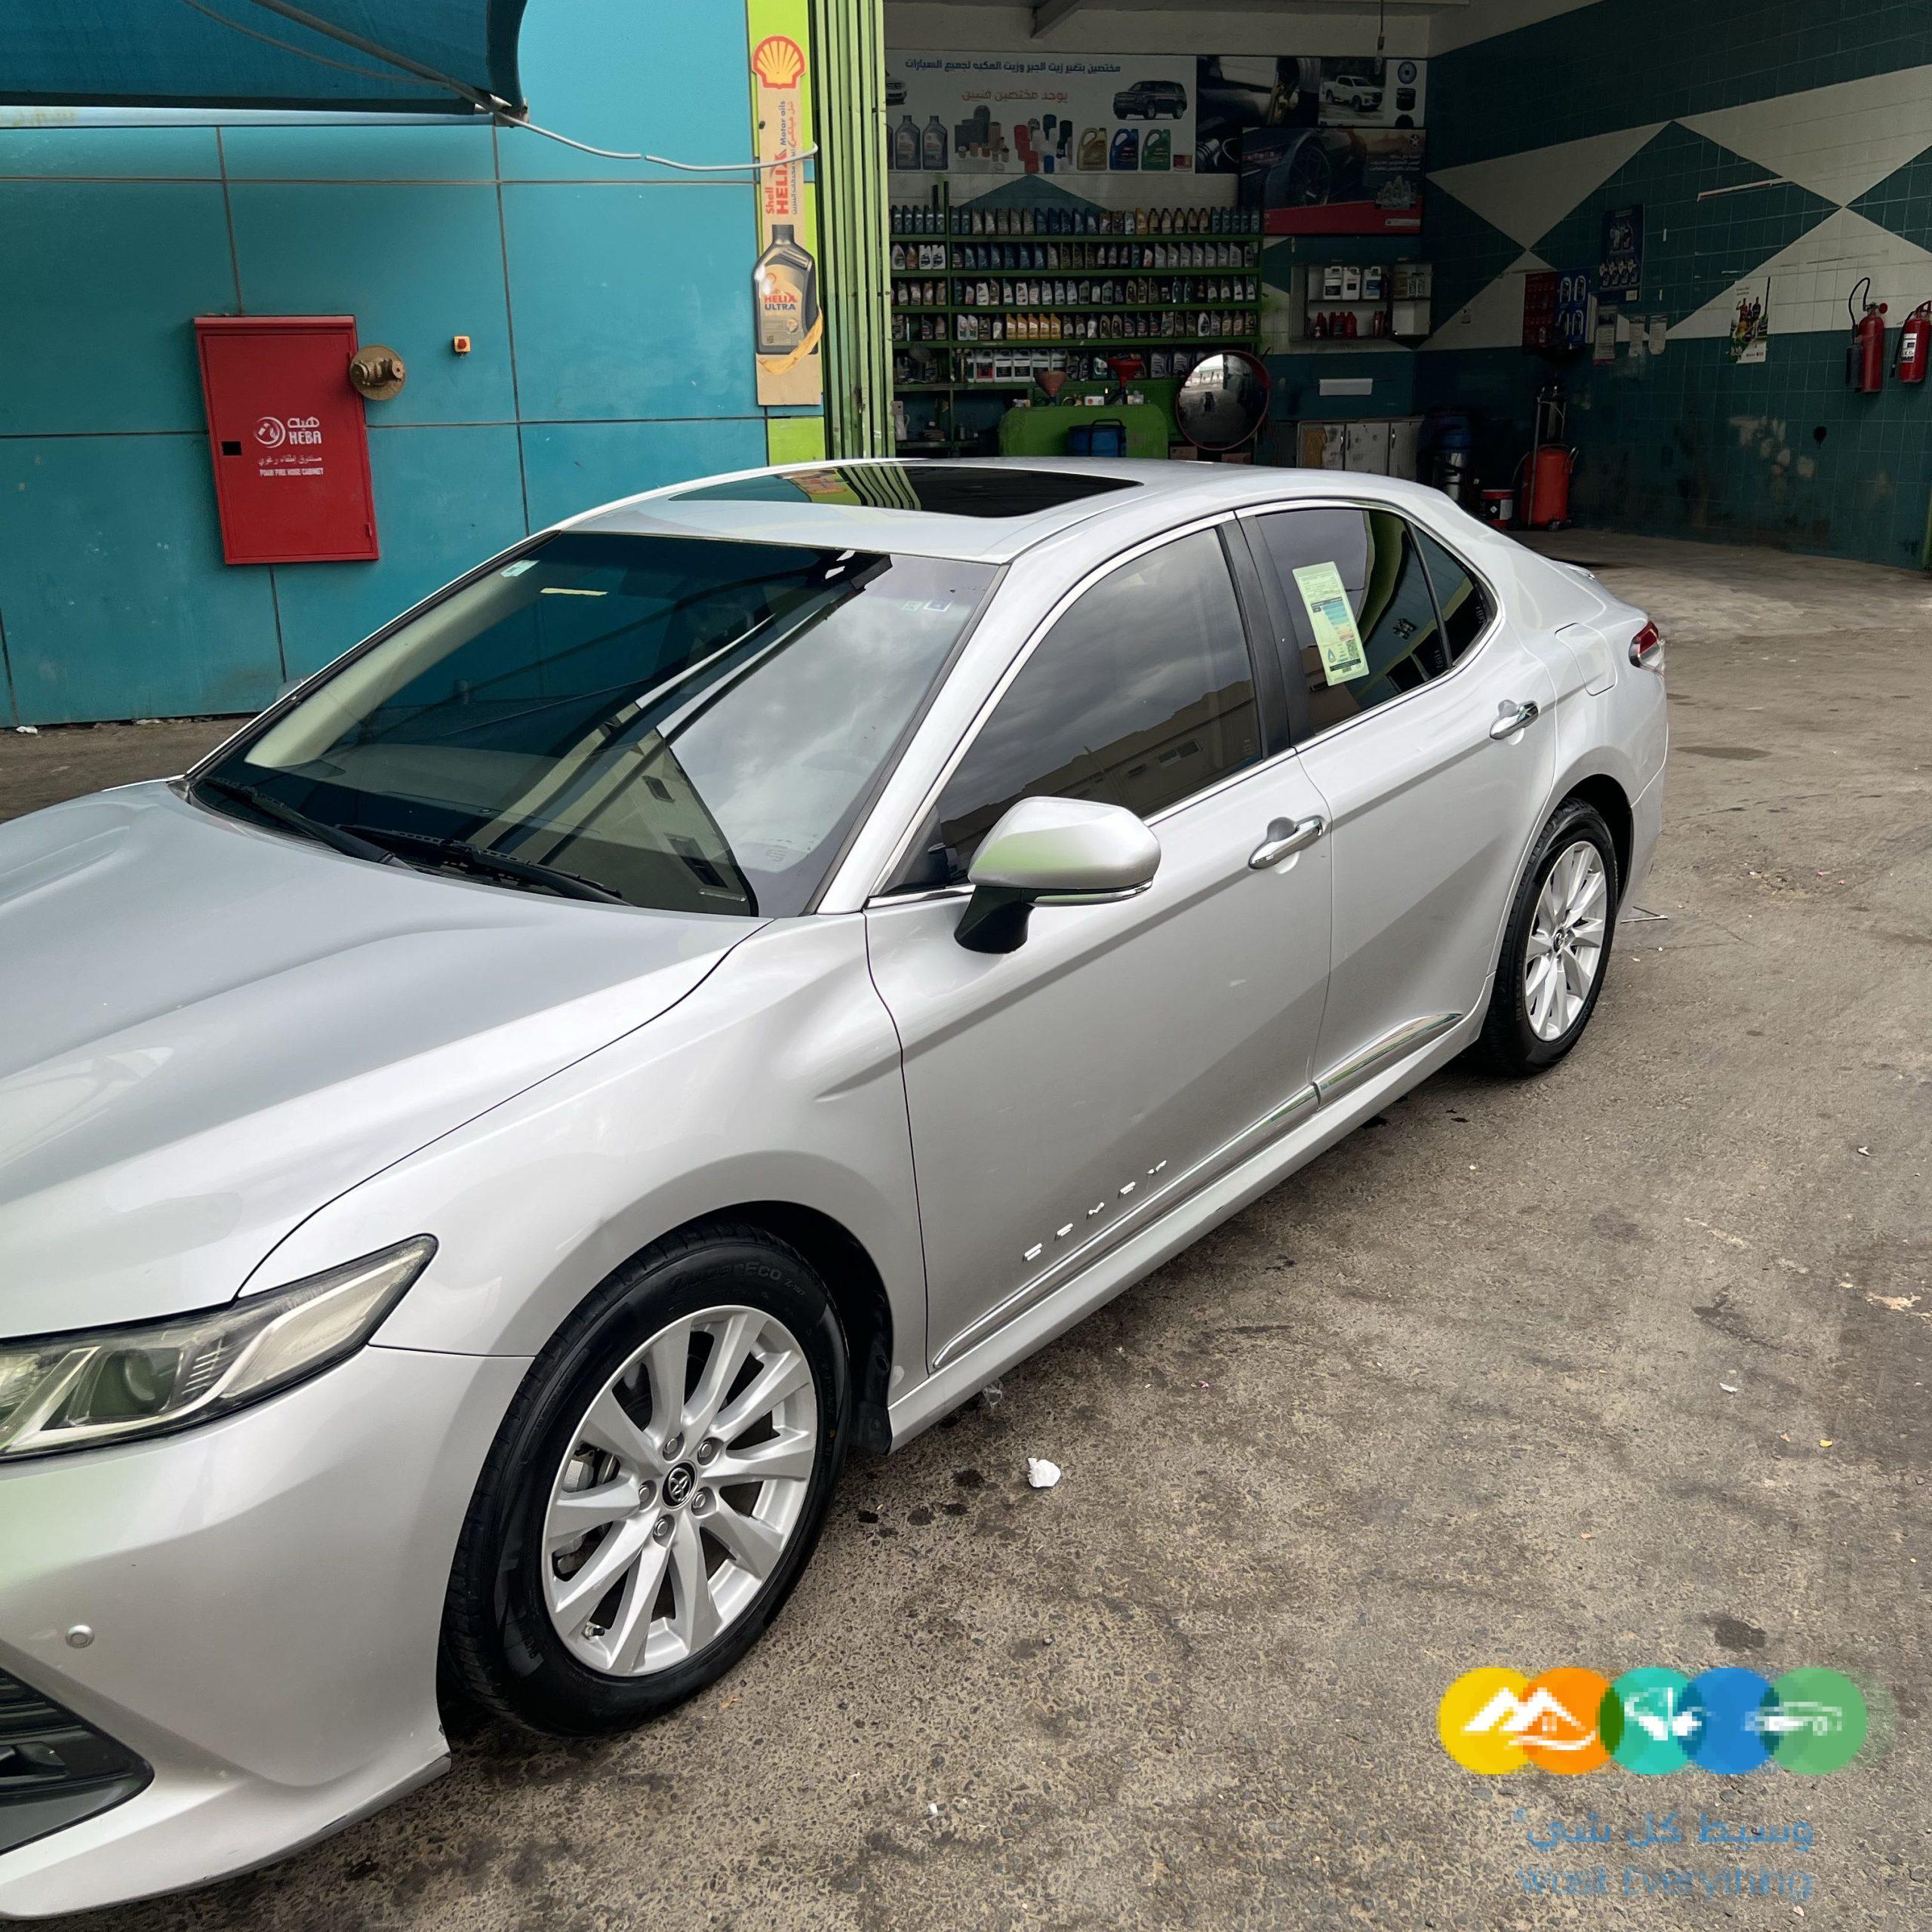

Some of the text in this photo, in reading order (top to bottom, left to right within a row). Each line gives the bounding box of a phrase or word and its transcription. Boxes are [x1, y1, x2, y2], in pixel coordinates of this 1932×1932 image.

[774, 150, 789, 215] HELIX
[764, 186, 774, 214] Shell
[763, 294, 797, 303] HELIX
[289, 431, 322, 445] HEBA
